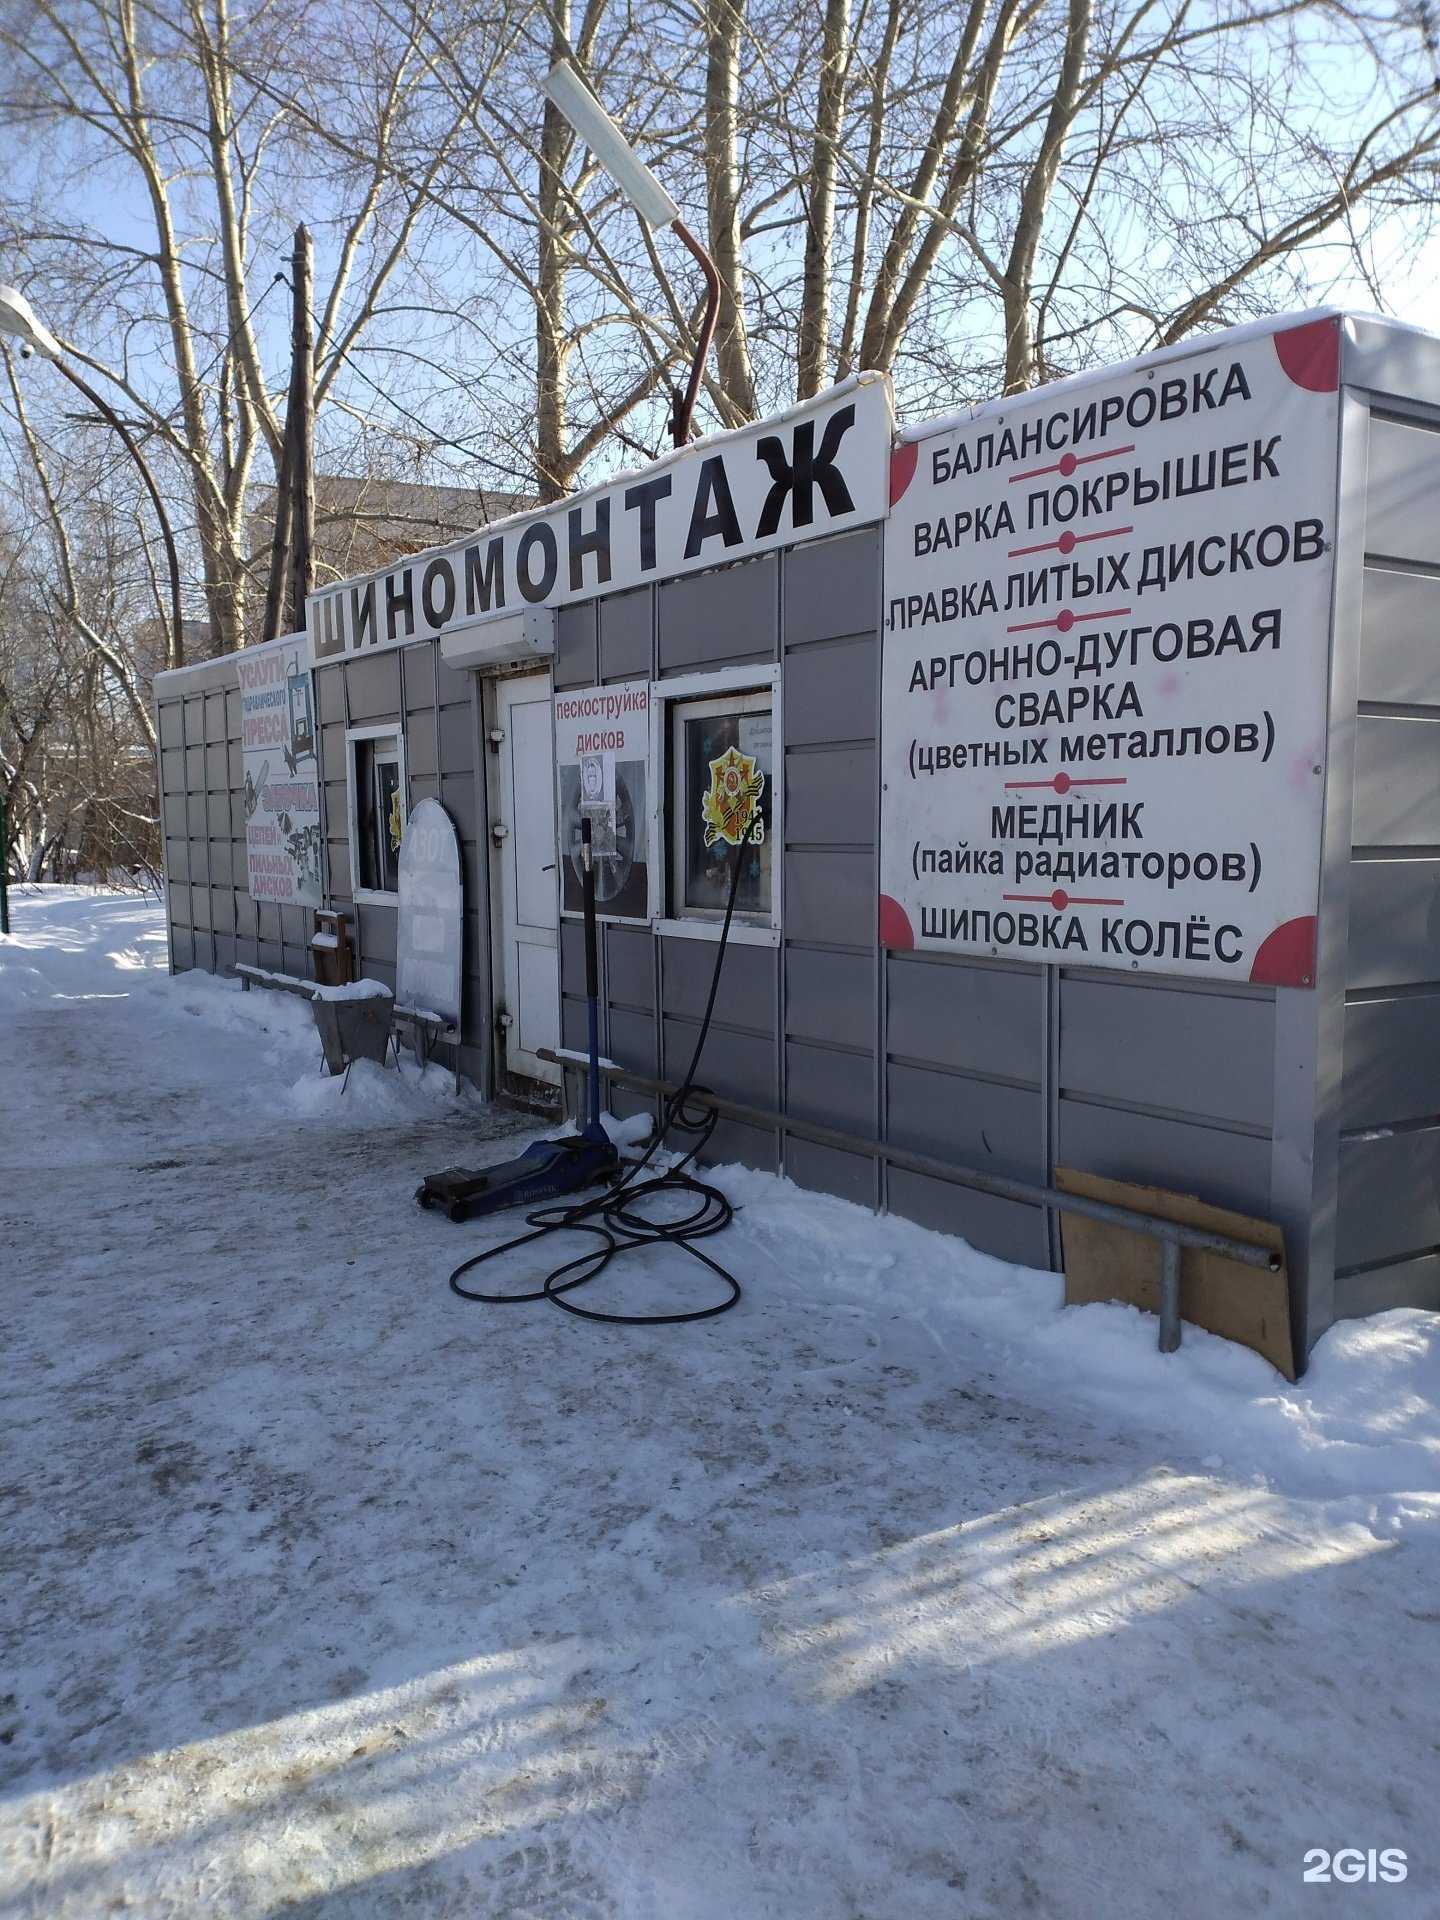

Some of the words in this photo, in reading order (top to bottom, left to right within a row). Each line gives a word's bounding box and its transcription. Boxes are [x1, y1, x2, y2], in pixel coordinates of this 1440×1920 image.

[932, 362, 1251, 485] БАЛАНСИРОВКА
[914, 500, 1015, 557] ВАРКА
[1027, 435, 1282, 530] ПОКРЫШЕК
[313, 403, 856, 659] ШИНОМОНТАЖ
[890, 580, 999, 631] ПРАВКА
[1004, 552, 1130, 611] ЛИТЫХ
[1137, 518, 1325, 595] ДИСКОВ
[909, 608, 1282, 693] АРГОННО-ДУГОВАЯ
[556, 687, 647, 720] пескоструйка
[994, 681, 1143, 729] СВАРКА
[576, 730, 625, 753] дисков
[909, 737, 1048, 778] (цветных
[1060, 710, 1275, 762] металлов)
[991, 802, 1144, 845] МЕДНИК
[253, 875, 293, 897] ДИСКОВ
[912, 841, 1004, 880] (пайка
[1015, 842, 1262, 892] радиаторов)
[920, 907, 1088, 951] ШИПОВКА
[1101, 915, 1244, 963] КОЛЁС
